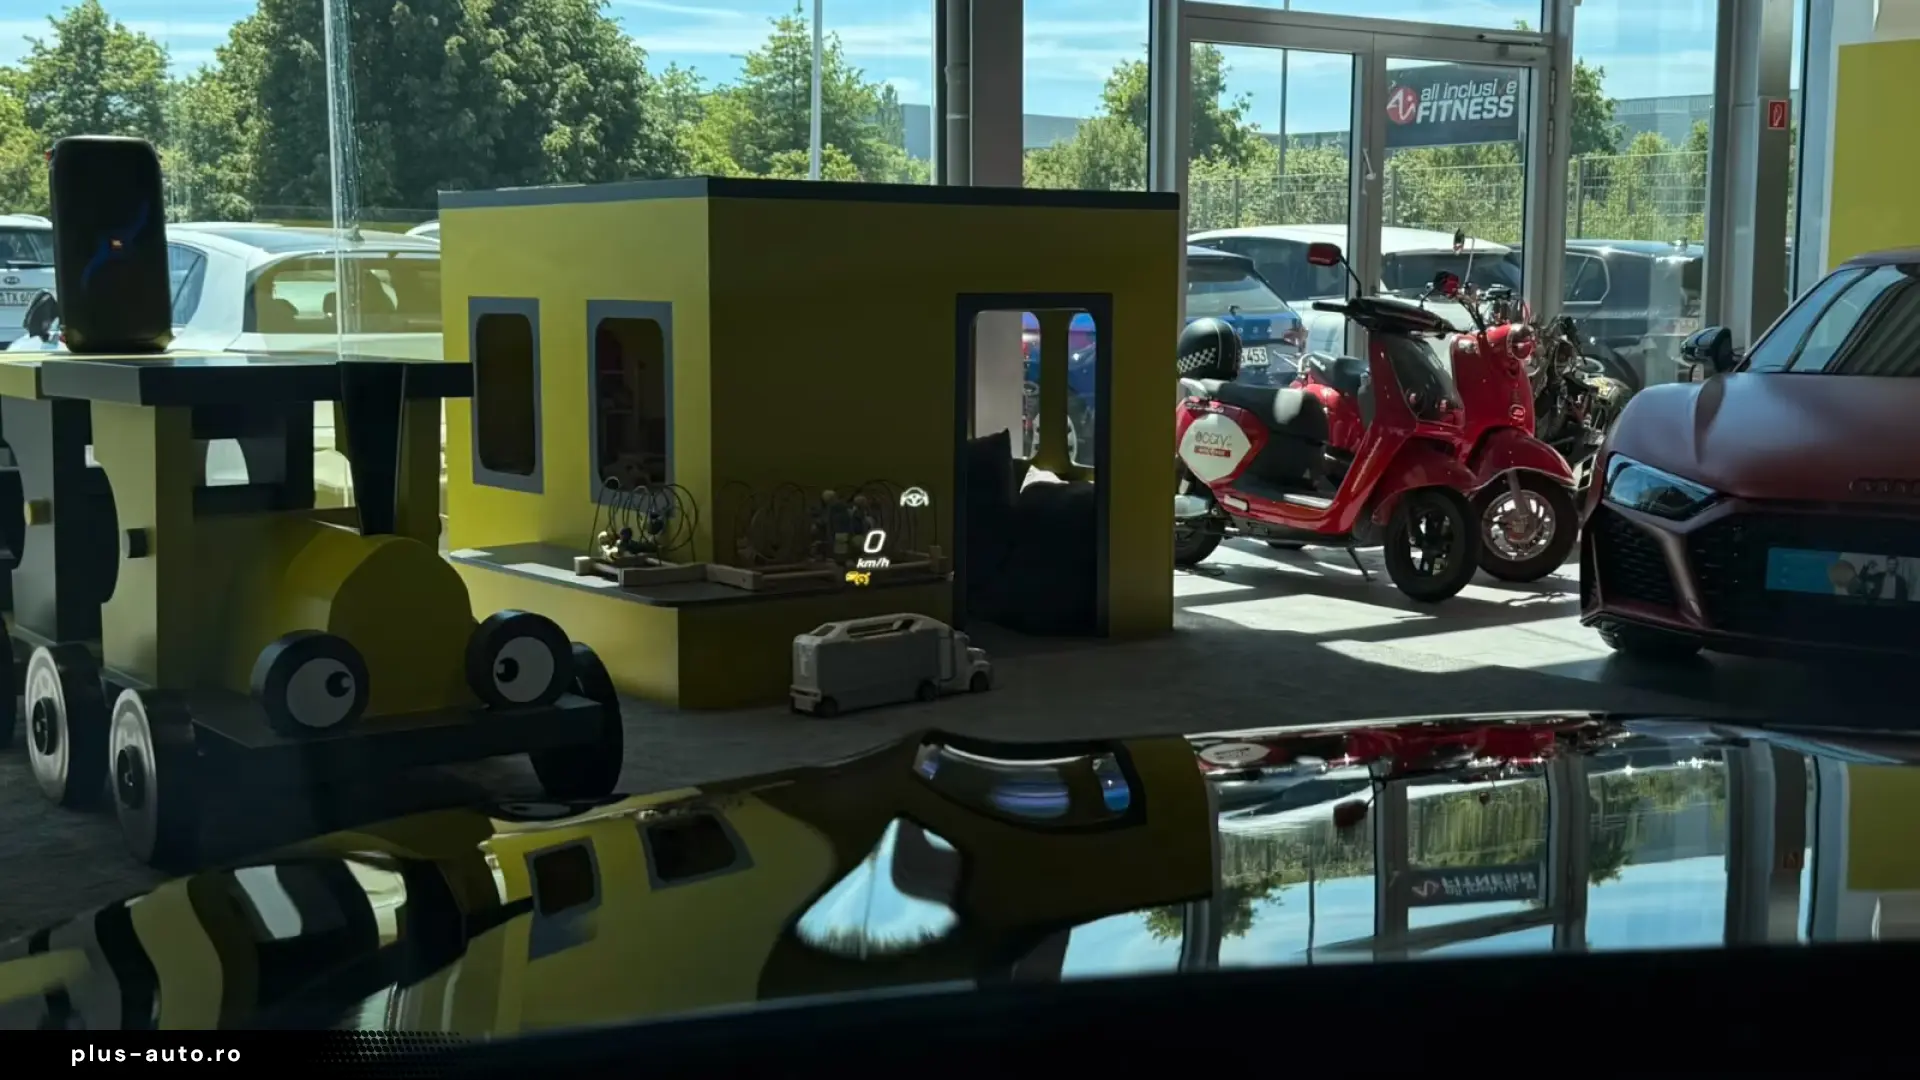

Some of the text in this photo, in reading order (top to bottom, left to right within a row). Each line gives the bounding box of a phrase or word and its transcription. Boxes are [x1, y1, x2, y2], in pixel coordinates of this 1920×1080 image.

[1420, 78, 1517, 101] all inclusie
[1416, 95, 1515, 124] FITNESS
[1246, 346, 1267, 361] 453
[863, 529, 886, 553] 0
[857, 557, 890, 568] km/h
